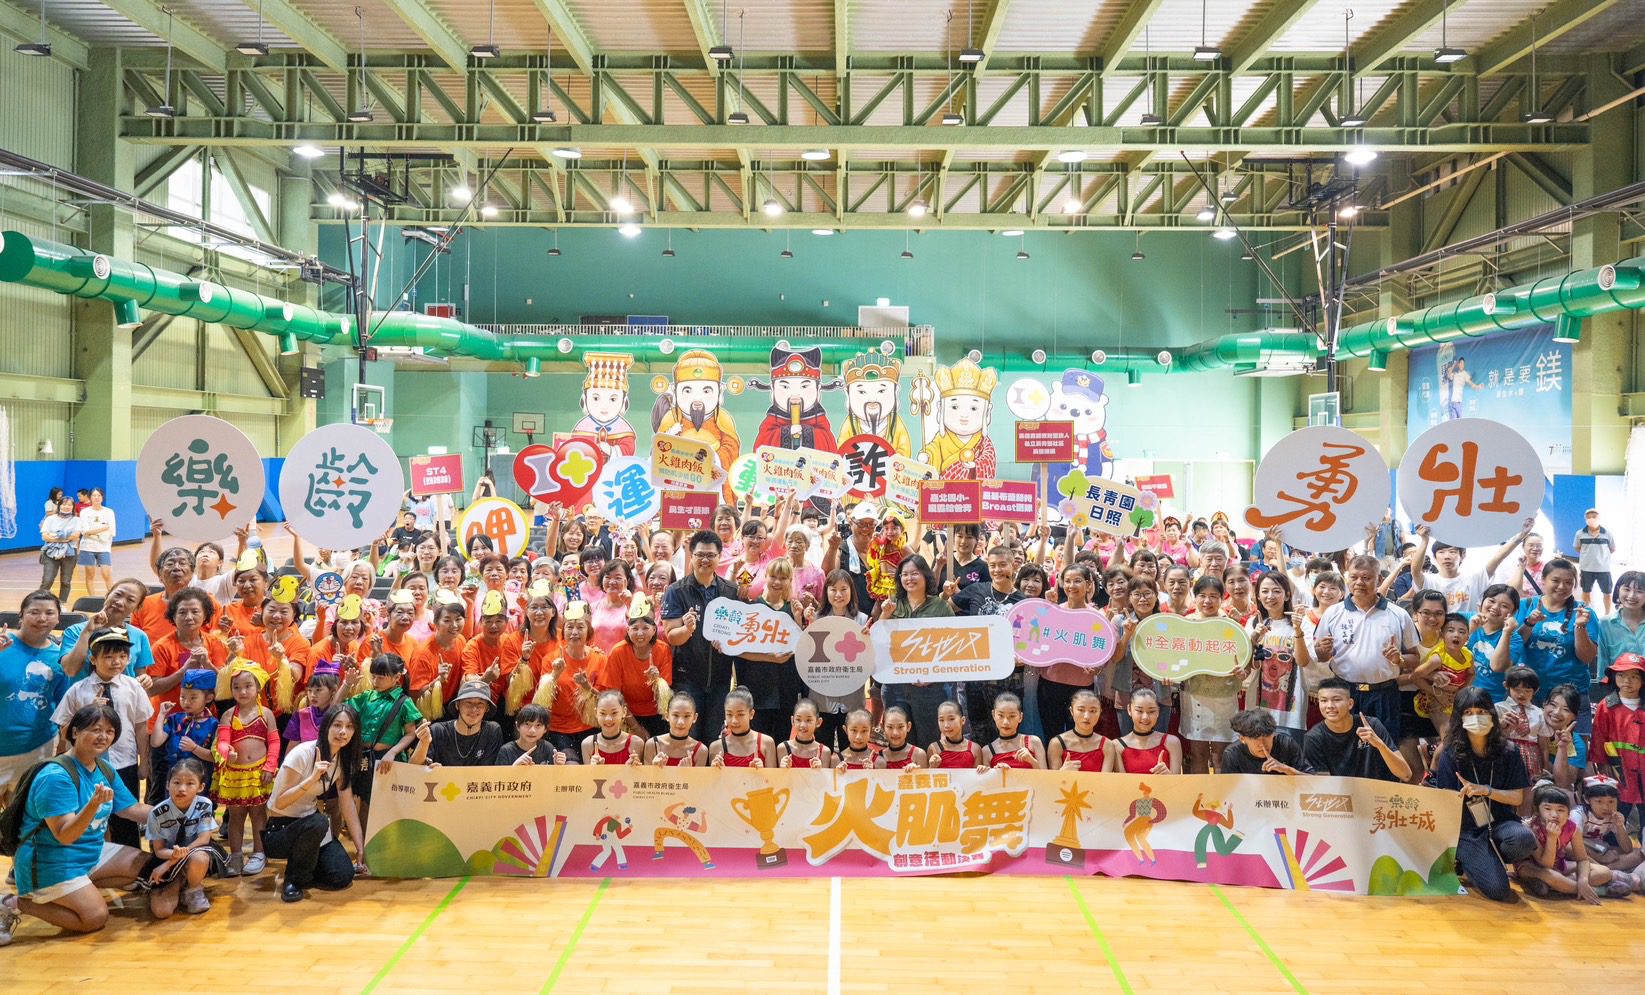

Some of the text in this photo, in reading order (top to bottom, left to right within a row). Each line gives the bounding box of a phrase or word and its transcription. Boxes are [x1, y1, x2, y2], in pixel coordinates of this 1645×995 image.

[425, 466, 447, 476] ST4
[659, 453, 705, 475] 火雞肉飯
[763, 464, 805, 480] 火雞肉飯
[845, 442, 889, 489] 詐
[161, 438, 240, 521] 樂
[304, 447, 379, 529] 齡
[1245, 441, 1365, 533] 勇
[1418, 441, 1523, 522] 壯
[602, 463, 655, 519] 運
[1086, 485, 1136, 511] 長青園
[1090, 505, 1122, 526] 日照
[714, 605, 743, 625] 樂齡
[727, 611, 791, 647] 勇壯
[1043, 627, 1106, 650] #火肌舞
[1146, 636, 1237, 654] #全嘉動起來
[808, 665, 863, 673] 嘉義市政府衛生局
[894, 664, 991, 675] Strong Generation
[391, 784, 416, 794] 指導單位
[466, 781, 532, 793] 嘉義市政府
[633, 781, 689, 790] 嘉義市政府衛生局
[801, 777, 1029, 860] 火肌舞
